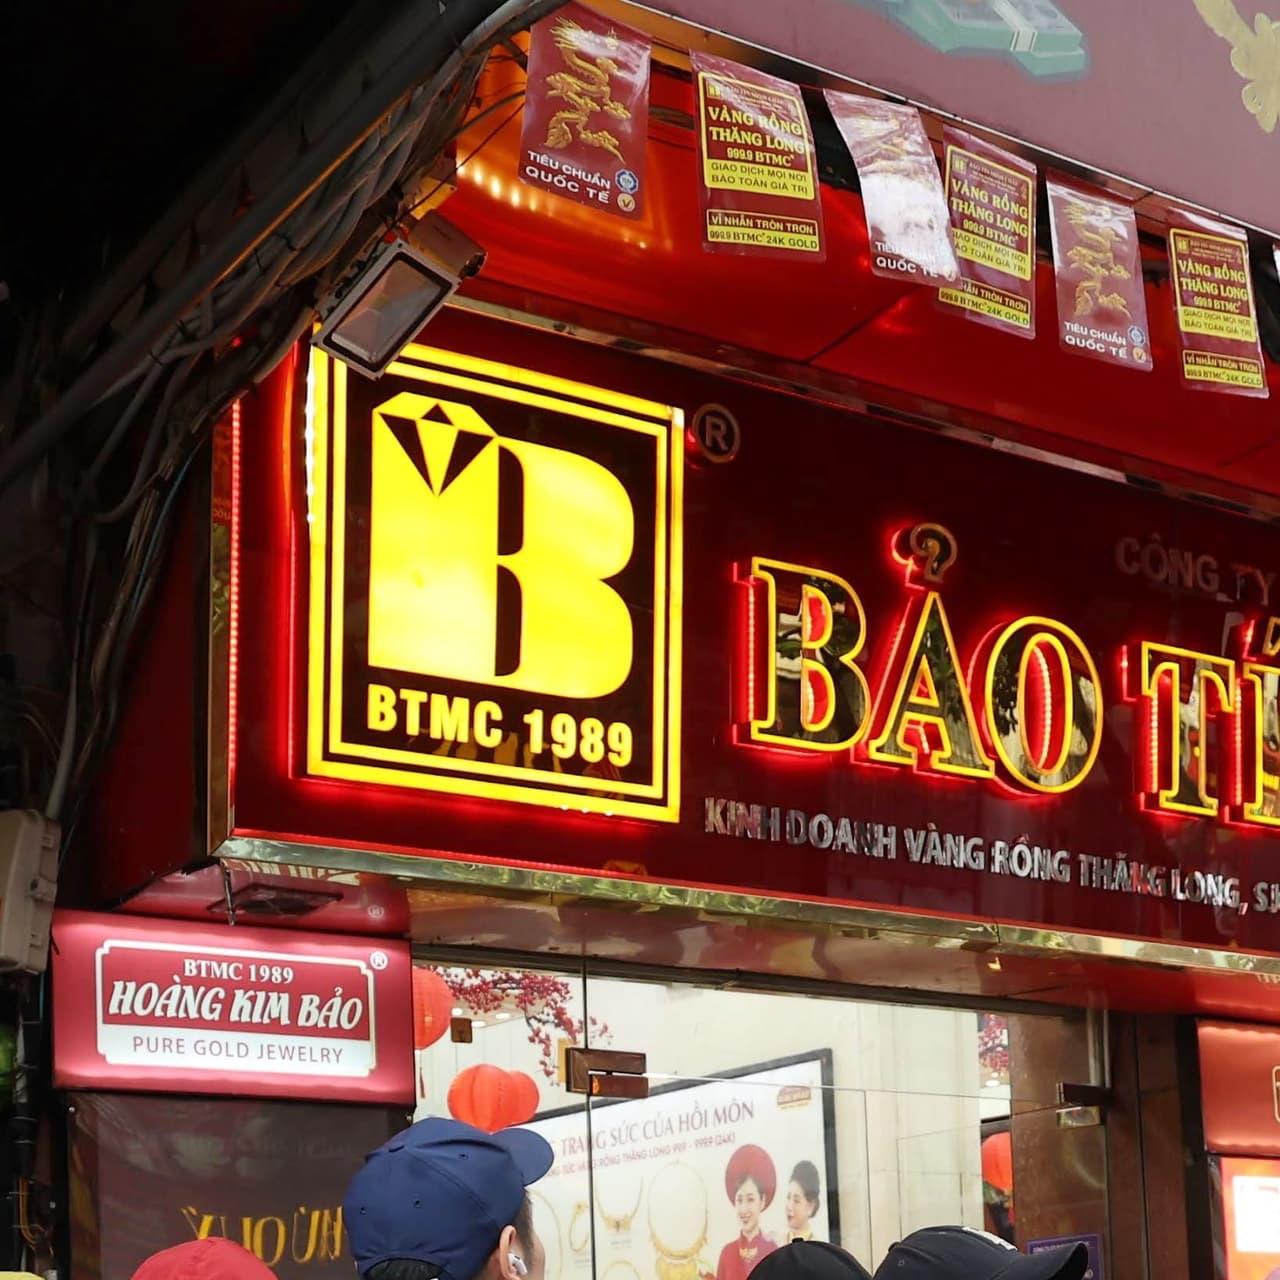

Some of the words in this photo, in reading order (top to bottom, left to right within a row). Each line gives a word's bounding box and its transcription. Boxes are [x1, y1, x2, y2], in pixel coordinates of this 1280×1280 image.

[708, 106, 754, 126] VÀNG
[709, 126, 762, 147] THĂNG
[766, 135, 805, 154] LONG
[525, 165, 579, 193] QUỐC
[586, 183, 609, 204] TẾ
[528, 151, 559, 172] TIÊU
[562, 162, 611, 190] CHUẨN
[711, 163, 737, 173] GIAO
[740, 165, 764, 176] DỊCH
[767, 169, 786, 180] MỌI
[738, 176, 768, 188] TOÀN
[771, 180, 789, 191] GIÁ
[792, 185, 808, 195] TRỊ
[952, 178, 989, 204] VÀNG
[992, 192, 1029, 219] RỒNG
[951, 197, 994, 224] THĂNG
[996, 214, 1029, 238] LONG
[788, 237, 818, 249] GOLD
[876, 257, 917, 274] QUỐC
[1178, 257, 1211, 277] VÀNG
[1220, 283, 1248, 301] LONG
[1064, 320, 1087, 339] TIÊU
[1089, 325, 1127, 346] CHUẨN
[1065, 333, 1105, 353] QUỐC
[1109, 342, 1128, 359] TẾ
[1116, 532, 1220, 592] CÔNG
[748, 522, 1103, 794] BẢO
[367, 684, 504, 748] BTMC
[522, 710, 634, 768] 1989
[704, 797, 781, 842] KINH
[785, 808, 897, 860] DOANH
[903, 822, 985, 870] VÀNG
[990, 833, 1071, 883] RỒNG
[1078, 850, 1167, 897] THĂNG
[183, 958, 243, 983] BTMC
[248, 962, 294, 986] 1989
[108, 974, 226, 1022] HOÀNG
[229, 988, 292, 1027] KIM
[296, 985, 364, 1031] BẢO
[132, 1035, 186, 1057] PURE
[193, 1038, 250, 1060] GOLD
[256, 1042, 344, 1065] JEWELRY
[609, 1120, 640, 1149] SỨC
[677, 1102, 709, 1134] HỒI
[713, 1096, 756, 1125] MÔN
